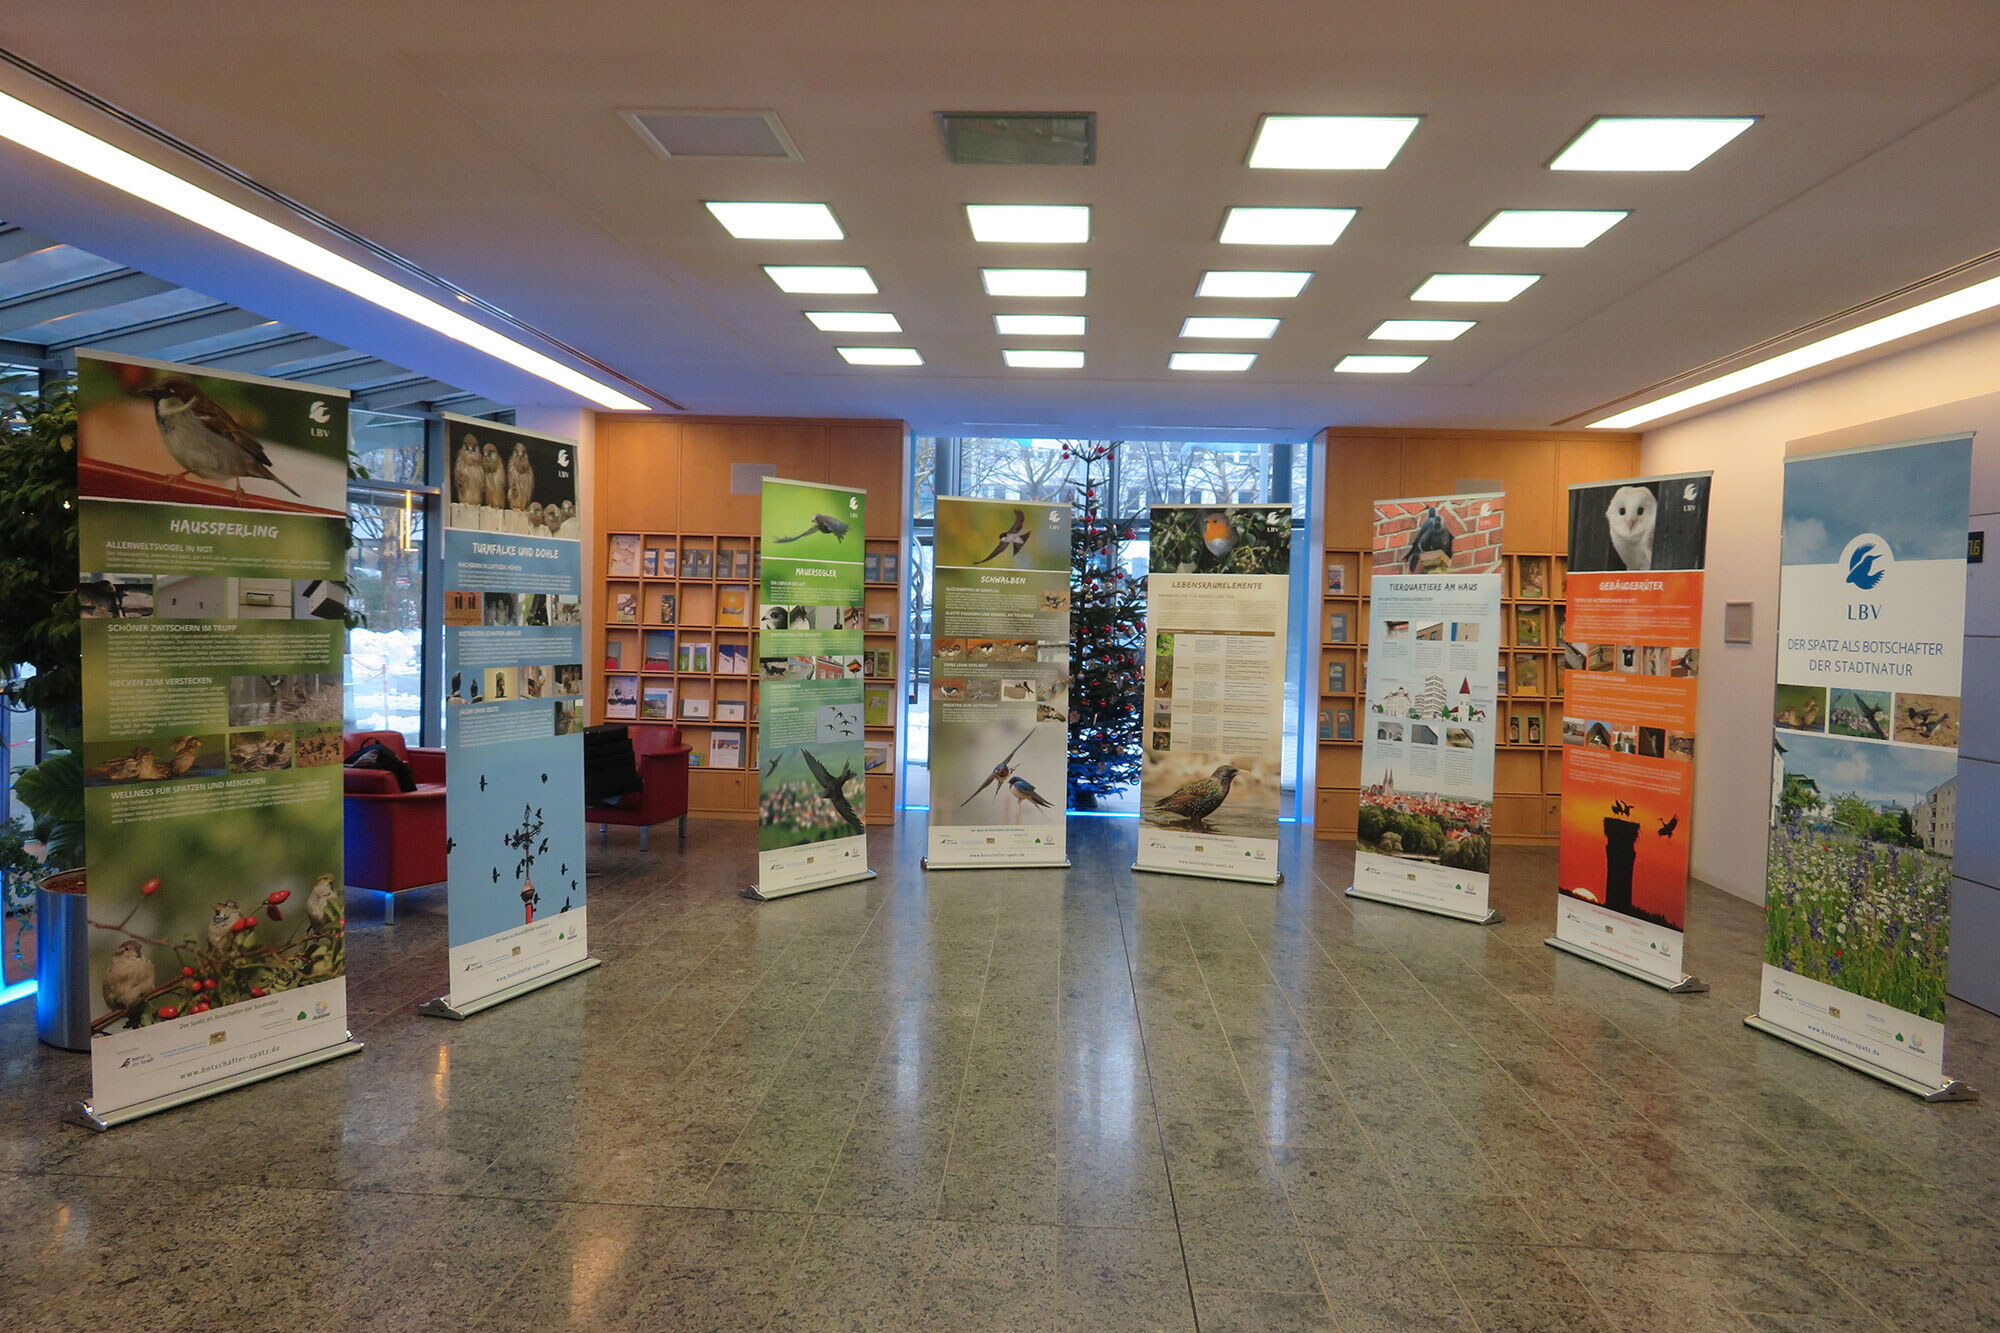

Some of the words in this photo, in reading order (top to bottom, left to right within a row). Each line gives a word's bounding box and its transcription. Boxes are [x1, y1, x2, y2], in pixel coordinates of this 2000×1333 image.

[310, 427, 330, 438] LBV
[170, 519, 279, 539] HAUSSPERLING
[106, 541, 184, 553] ALLERWELTSVOGEL
[185, 545, 195, 553] IN
[472, 542, 517, 556] TURMFALKE
[518, 546, 534, 557] UND
[535, 548, 559, 559] DOHLE
[795, 568, 837, 578] MAUERSEGLER
[980, 575, 1026, 585] SCHWALBEN
[1172, 581, 1263, 590] LEBENSRAUMELEMENTE
[1599, 579, 1664, 592] GEBÄUDEBRÜTER
[1389, 583, 1442, 591] TIERQUARTIERE
[1444, 583, 1455, 591] AM
[1458, 583, 1478, 591] HAUS
[1847, 604, 1883, 621] LBV
[107, 623, 149, 632] SCHÖNER
[150, 624, 201, 632] ZWITSCHERN
[1787, 638, 1806, 651] DER
[1808, 639, 1839, 652] SPATZ
[1841, 640, 1861, 653] ALS
[1863, 641, 1943, 656] BOTSCHAFTER
[1809, 659, 1832, 672] DER
[1834, 660, 1913, 676] STADTNATUR
[109, 679, 144, 687] HECKEN
[145, 678, 164, 686] ZUM
[165, 676, 213, 685] VERSTECKEN
[111, 789, 154, 800] WELLNESS
[155, 785, 171, 795] FÜR
[172, 783, 206, 794] SPATZEN
[207, 781, 225, 790] UND
[225, 777, 267, 787] MENSCHEN
[179, 1045, 280, 1080] www.botschafter-spatz.de
